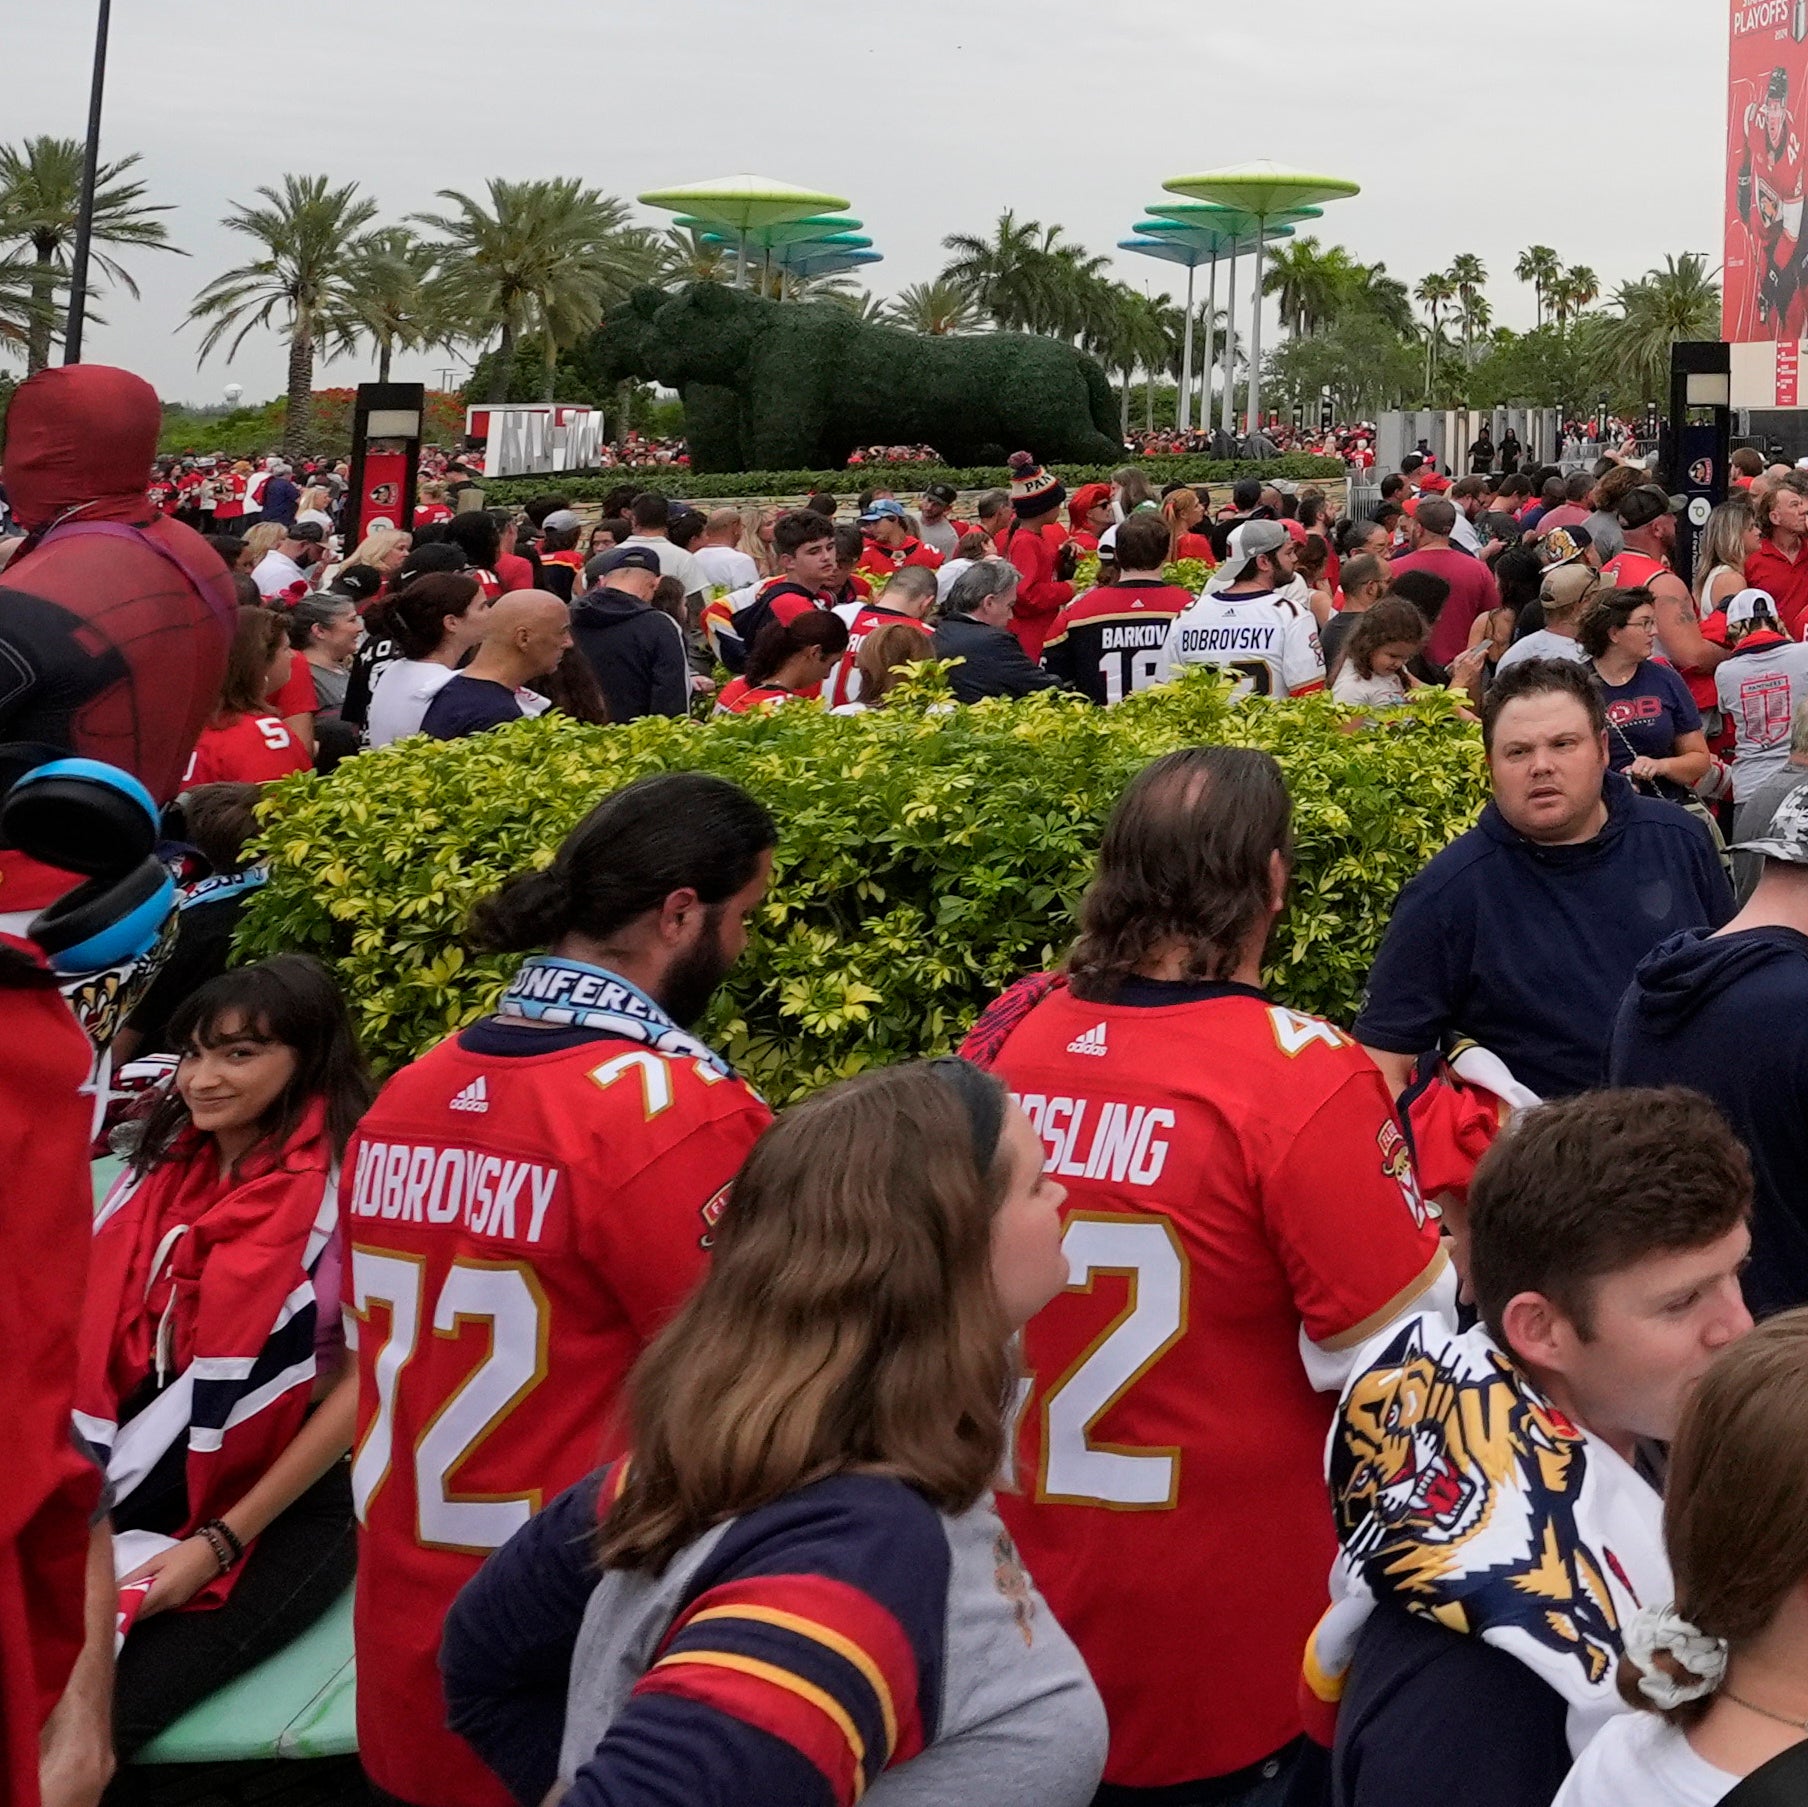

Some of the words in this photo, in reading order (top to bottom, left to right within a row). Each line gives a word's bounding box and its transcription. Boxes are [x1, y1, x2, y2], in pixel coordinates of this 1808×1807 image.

[1102, 625, 1168, 649] BARKOV
[1182, 627, 1275, 652] BOBROVSKY
[254, 717, 291, 750] 5
[1067, 1042, 1107, 1057] adidas
[449, 1098, 489, 1114] adidas
[1012, 1092, 1176, 1186] SLING
[351, 1140, 559, 1243] BOBROVSKY
[351, 1243, 550, 1556] 72
